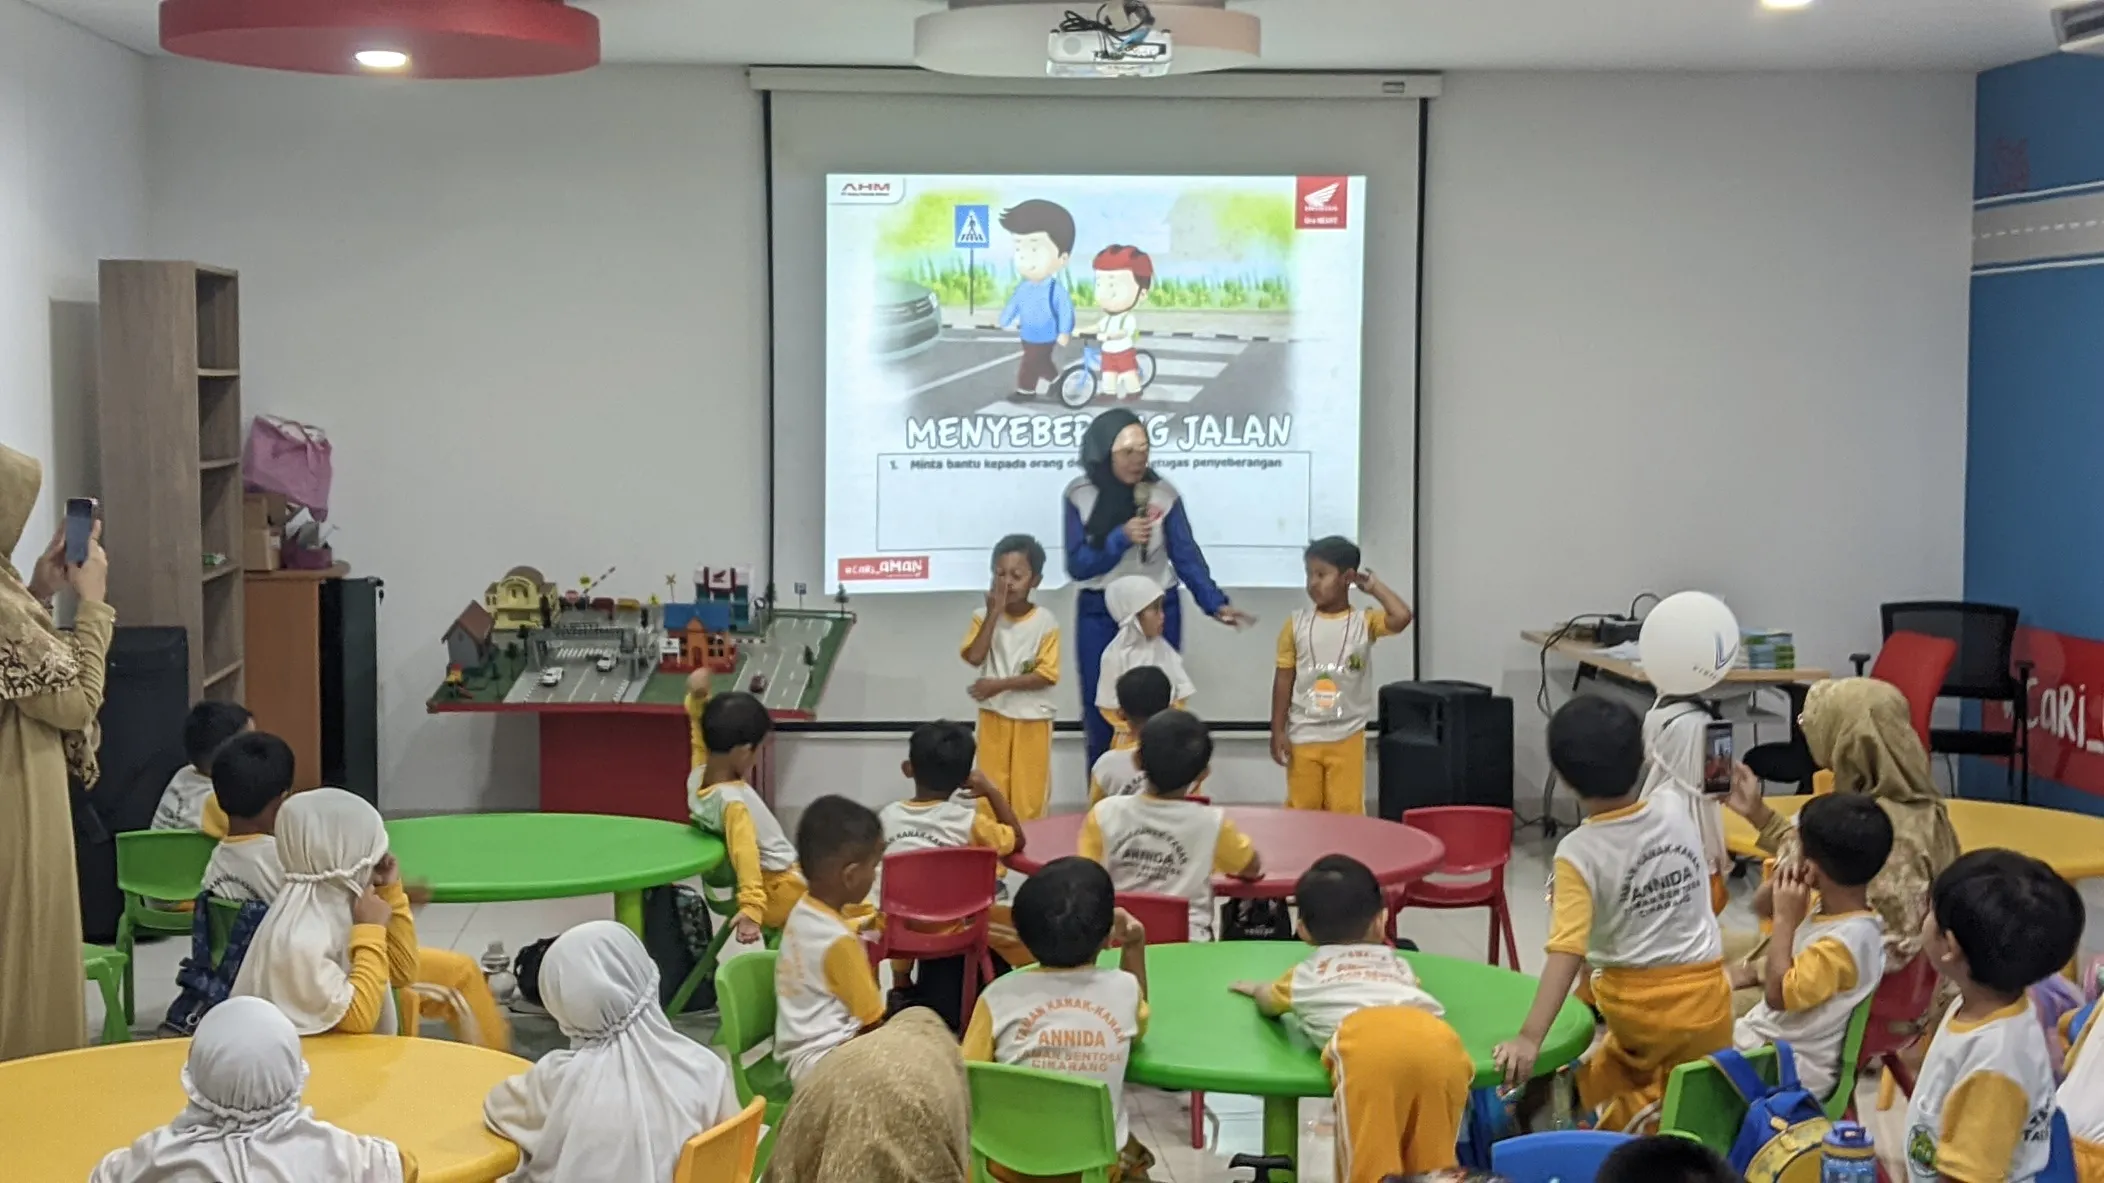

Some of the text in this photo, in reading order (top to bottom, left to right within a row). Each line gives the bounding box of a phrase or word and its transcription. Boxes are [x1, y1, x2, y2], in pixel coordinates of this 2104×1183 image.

[842, 183, 890, 191] AHM
[1176, 413, 1292, 451] JALAN
[910, 459, 943, 469] Minta
[946, 459, 981, 469] bantu
[984, 459, 1027, 472] kepada
[1029, 460, 1063, 471] orang
[1192, 458, 1282, 469] penyeberangan
[1632, 866, 1693, 901] ANNIDA
[1039, 1028, 1105, 1049] ANNIDA
[1031, 1060, 1108, 1073] CIKARANG
